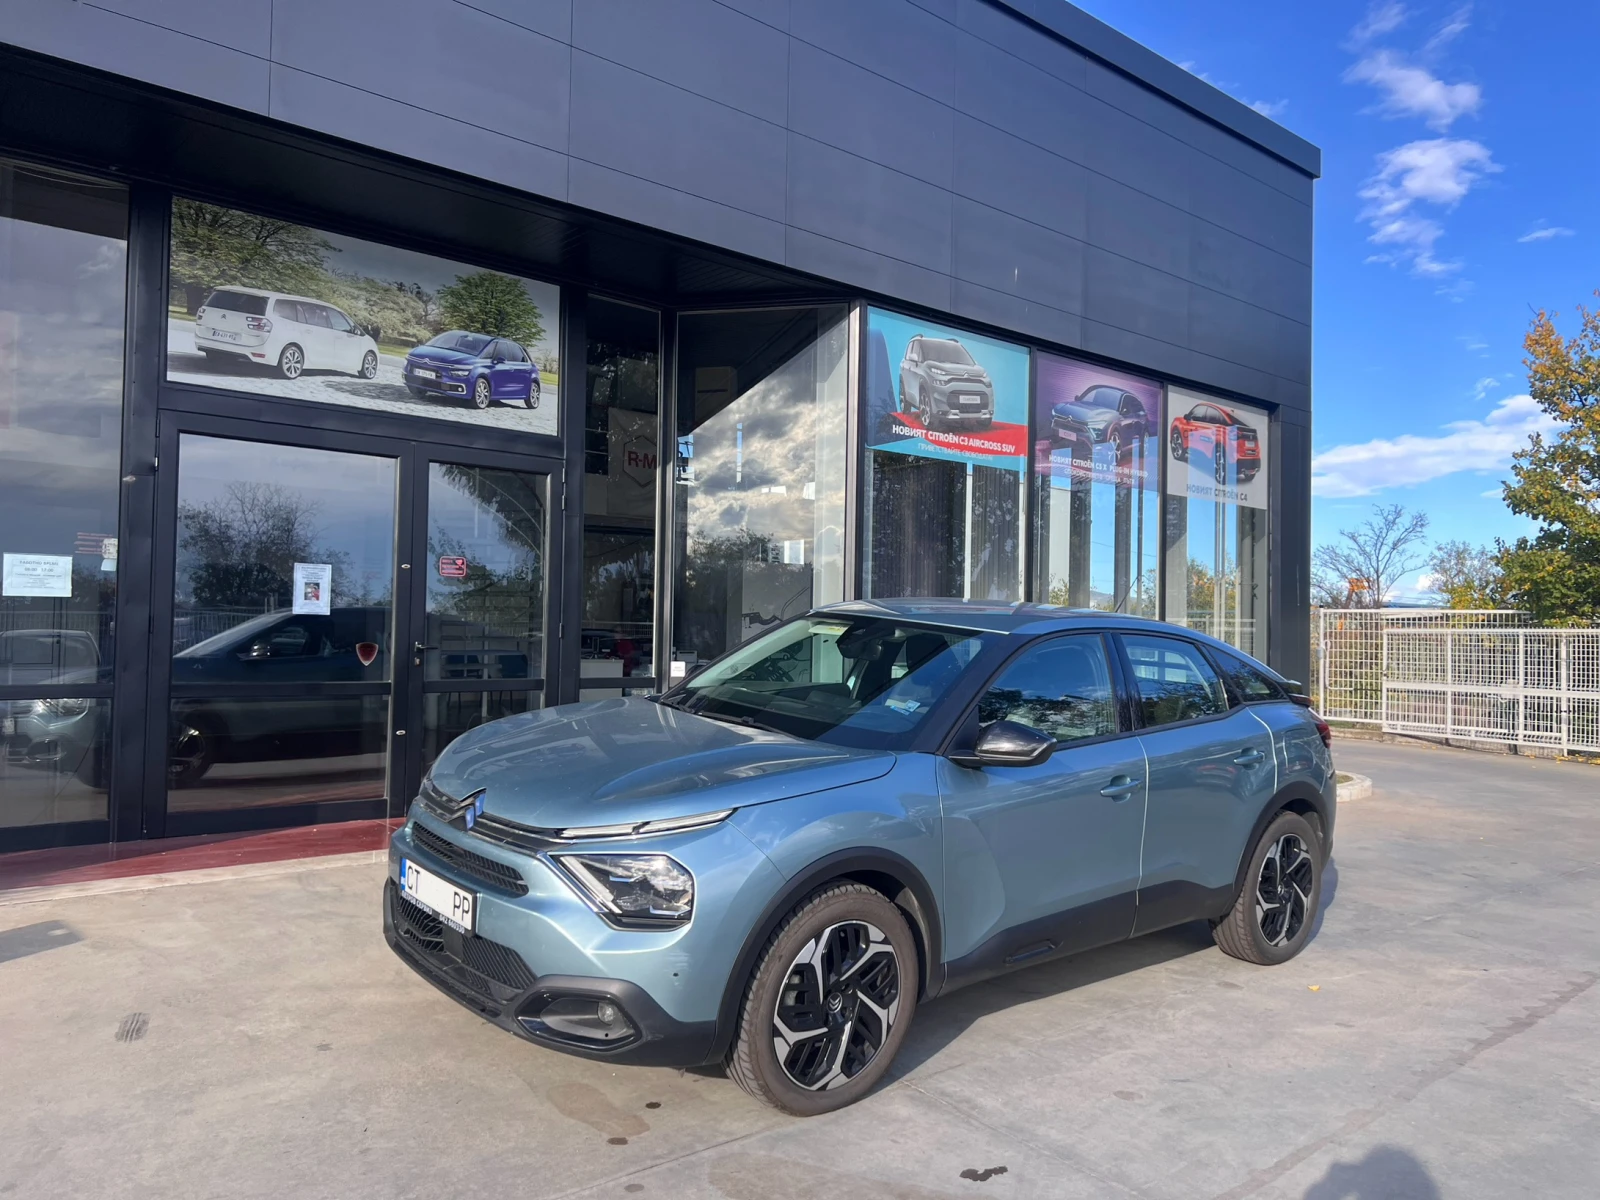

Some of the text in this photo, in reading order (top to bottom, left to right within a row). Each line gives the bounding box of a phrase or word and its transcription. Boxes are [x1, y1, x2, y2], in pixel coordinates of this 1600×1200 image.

[892, 424, 1015, 453] НОВИЯТ CITROËN C3 AIRCROSS SUV
[628, 451, 657, 469] R-M
[1049, 454, 1072, 464] НОВИЯТ
[1072, 458, 1094, 468] CITROËN
[1187, 484, 1248, 501] НОВИЯТ CITROËN C4
[407, 865, 470, 921] CT PP
